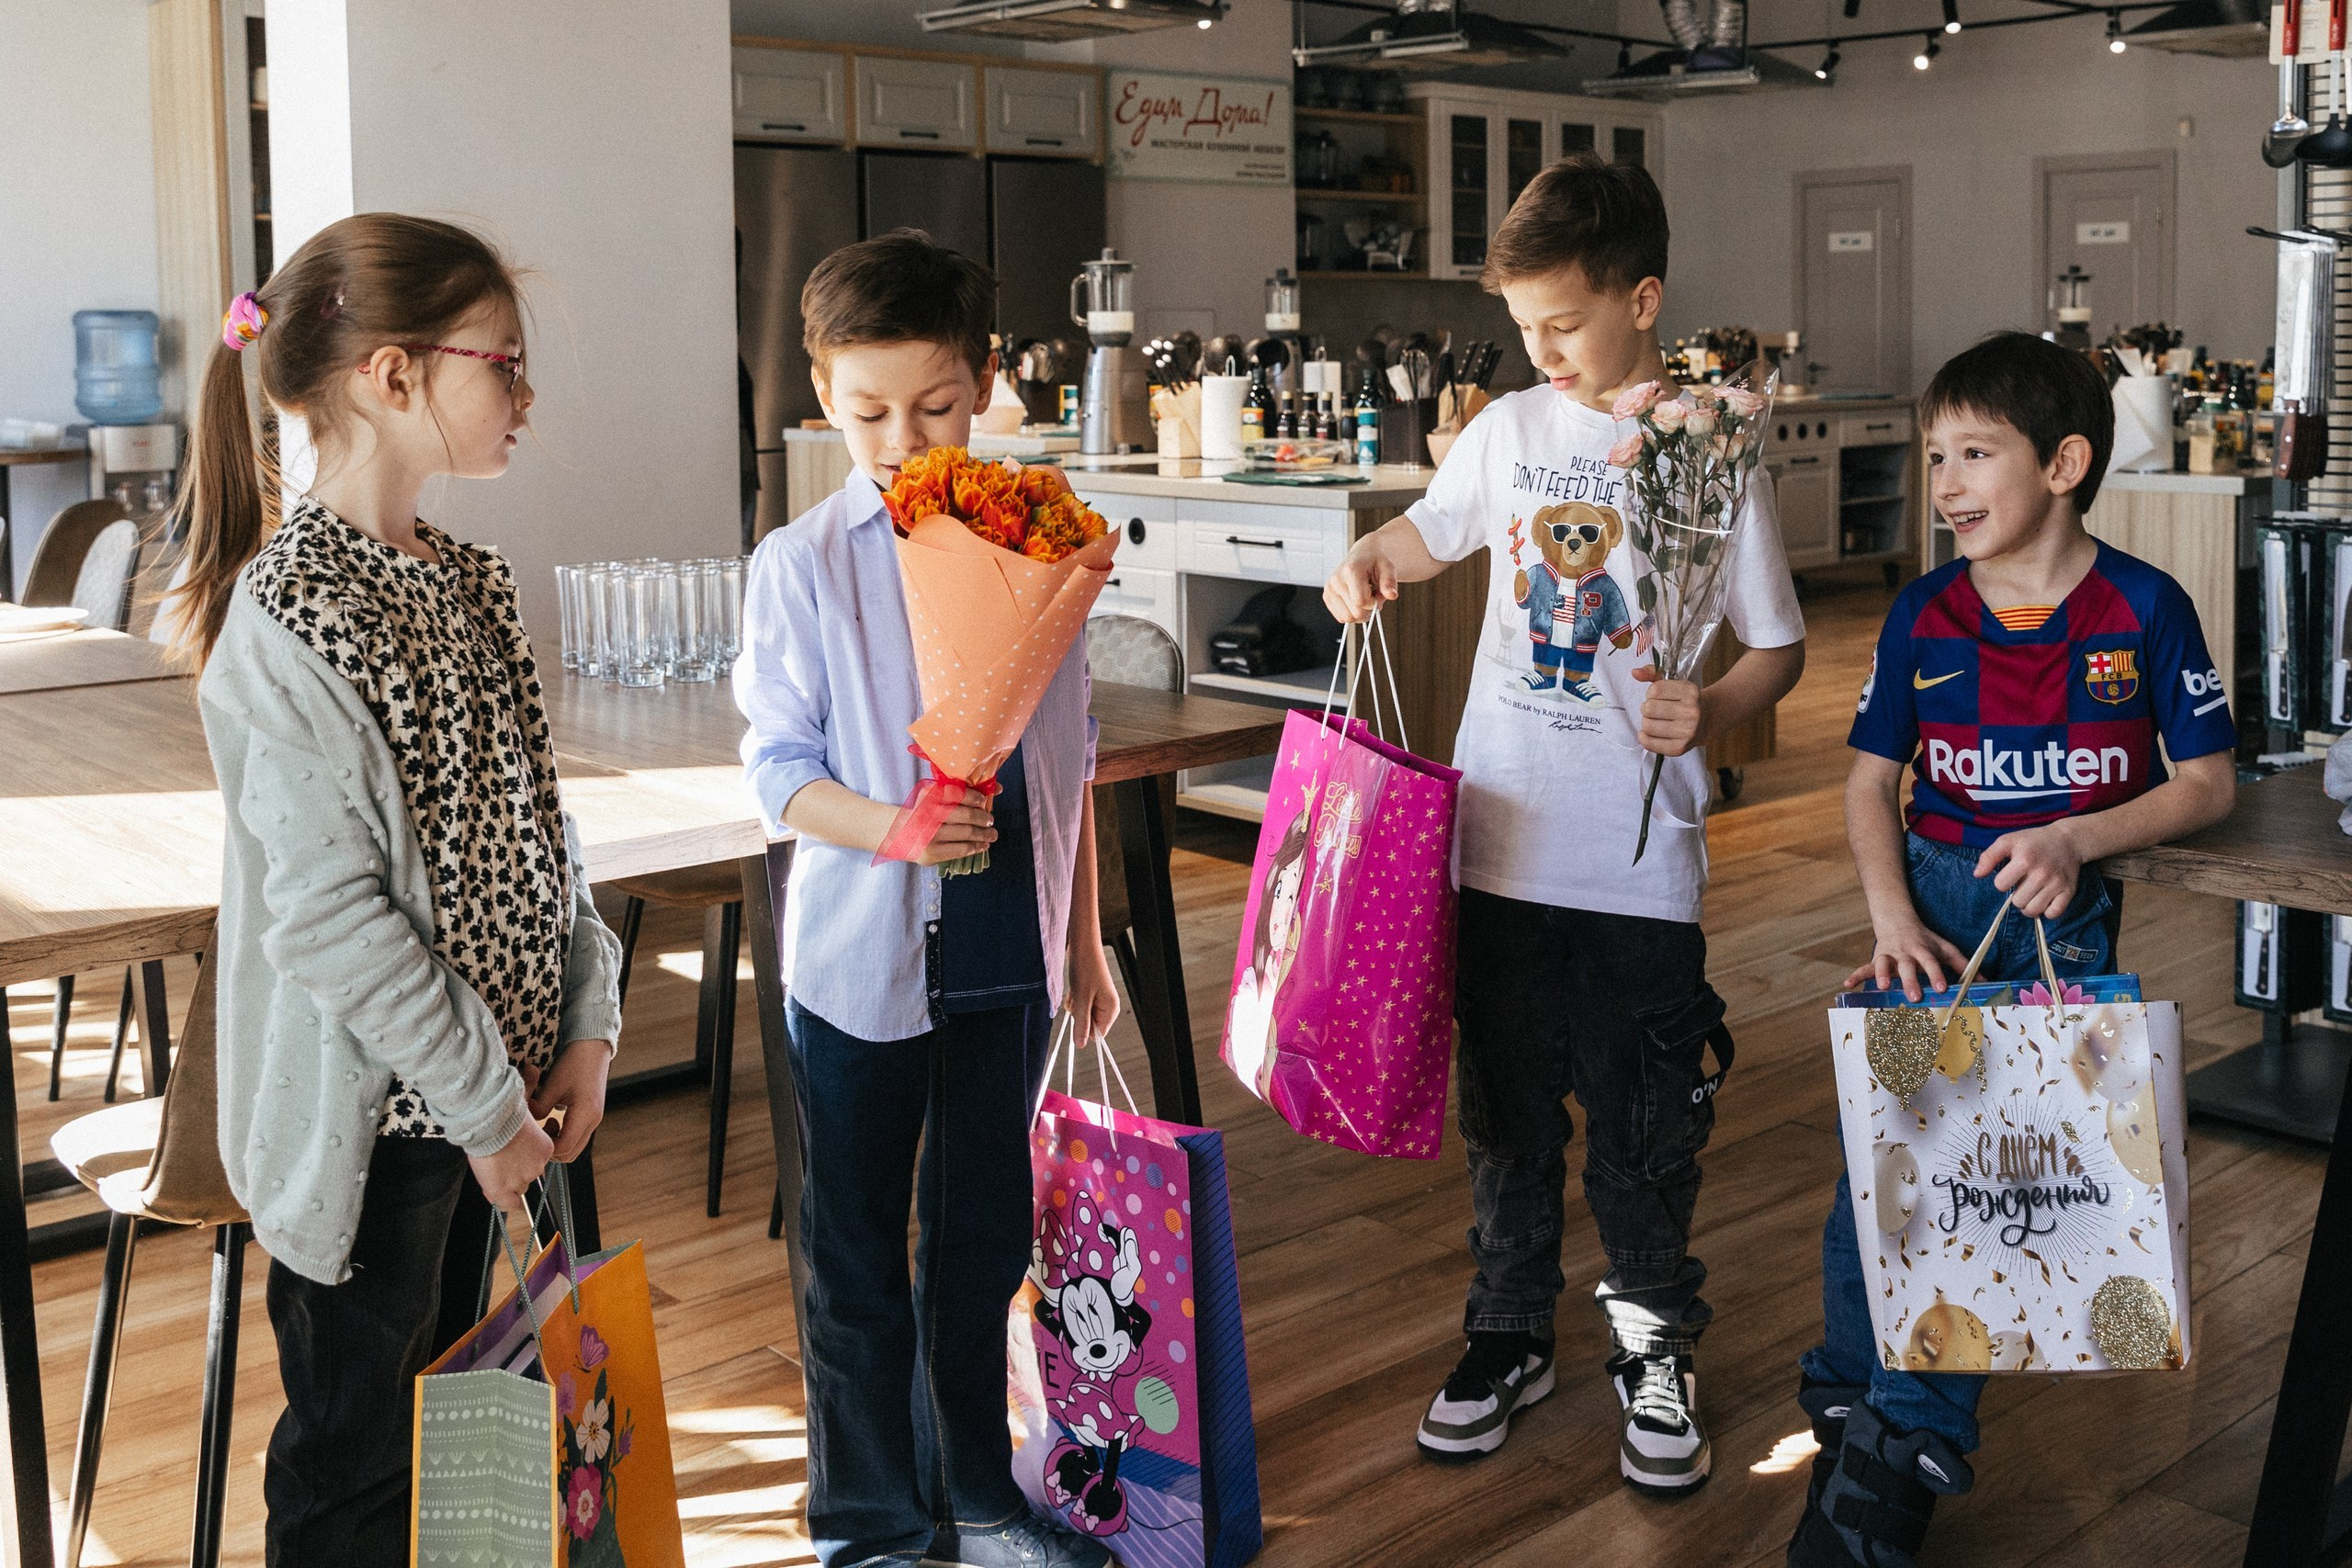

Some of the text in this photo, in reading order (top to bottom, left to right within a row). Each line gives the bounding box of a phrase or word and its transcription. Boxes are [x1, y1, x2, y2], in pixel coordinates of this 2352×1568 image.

[1115, 81, 1274, 147] Едим Дома!
[1513, 462, 1547, 492] DON'T
[1545, 471, 1589, 500] FEED
[1592, 476, 1623, 504] THE
[1570, 456, 1611, 476] PLEASE
[1498, 694, 1600, 725] POLO BEAR by RALPH LAUREN
[1929, 739, 2128, 787] Rakuten
[1323, 784, 1362, 820] Lile
